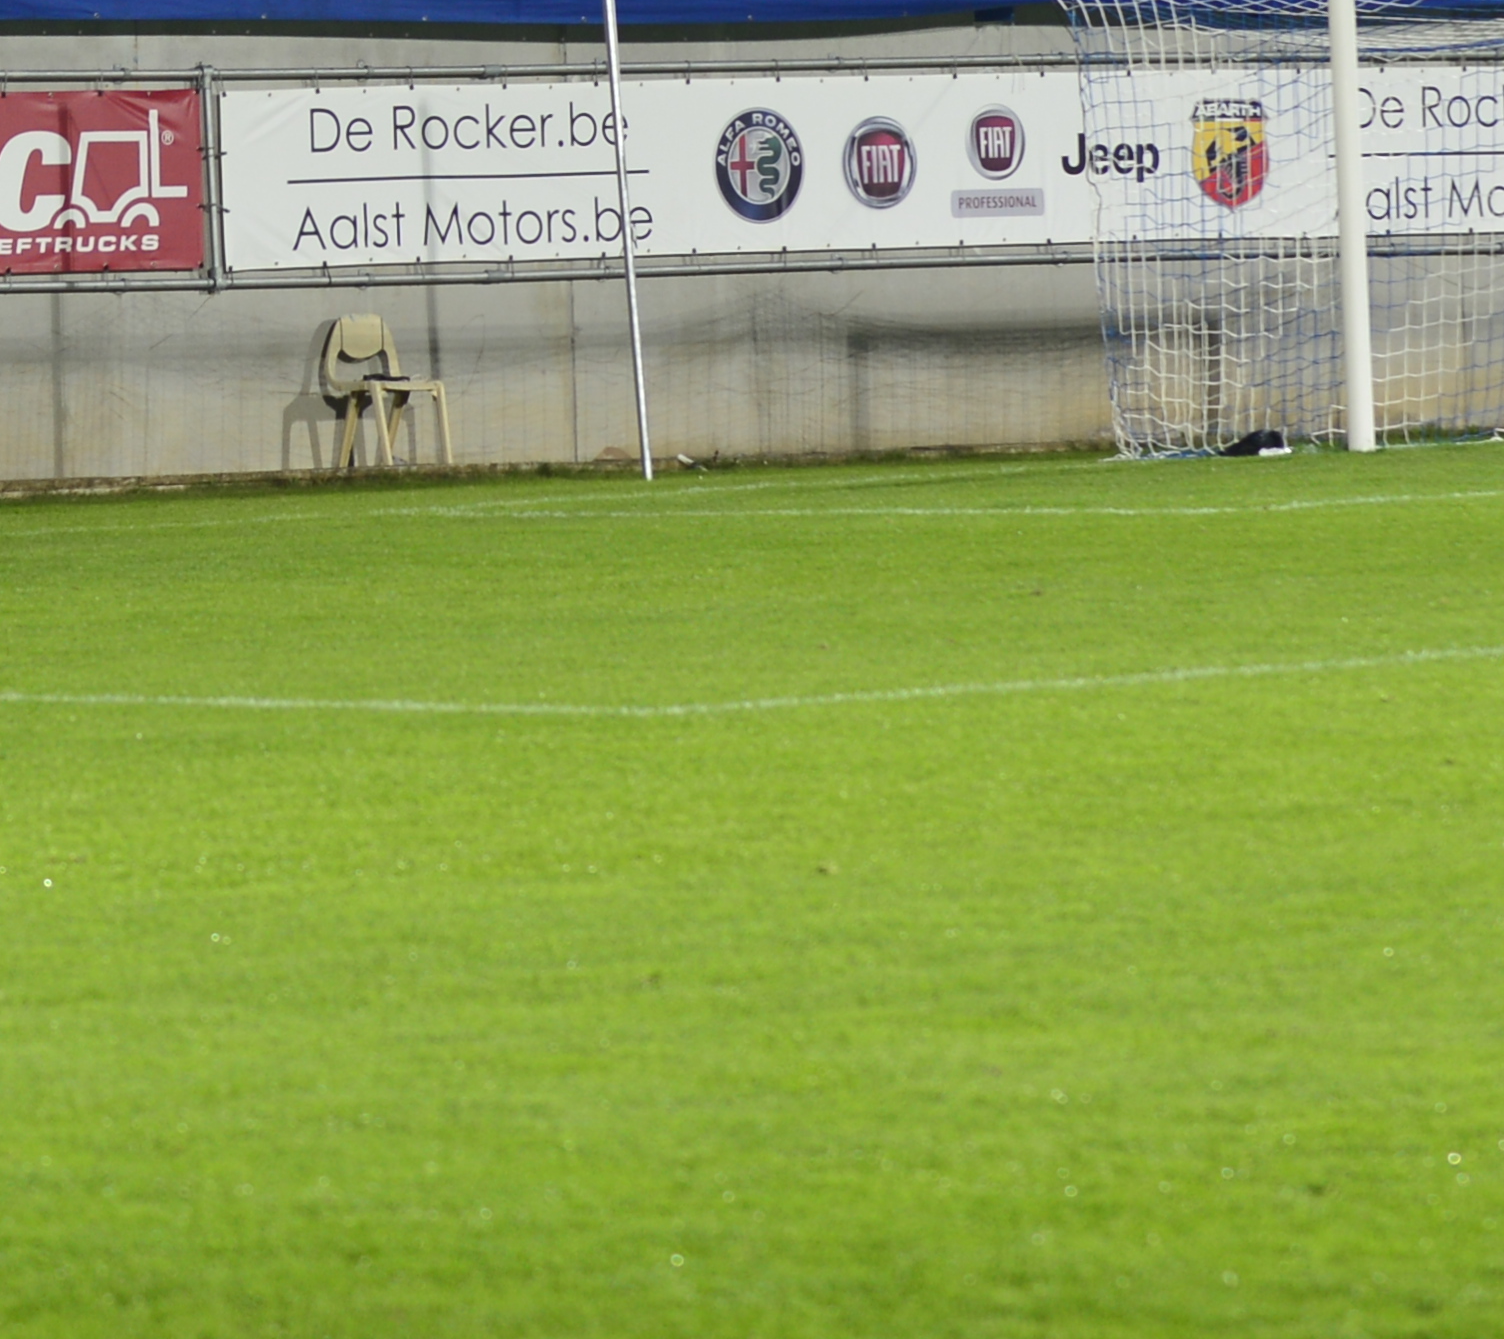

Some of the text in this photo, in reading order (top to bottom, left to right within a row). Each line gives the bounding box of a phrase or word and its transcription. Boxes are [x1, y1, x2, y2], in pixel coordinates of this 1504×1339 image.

[308, 101, 630, 154] De Rocker.be
[1193, 101, 1262, 118] ABARTH
[715, 111, 804, 169] ALFA ROMEO
[978, 125, 1015, 160] FIAT
[1061, 132, 1160, 184] Jeep
[859, 142, 904, 186] FIAT
[956, 193, 1039, 211] PROFESSIONAL
[1358, 177, 1433, 221] alst
[291, 196, 654, 252] Aalst Motors.be
